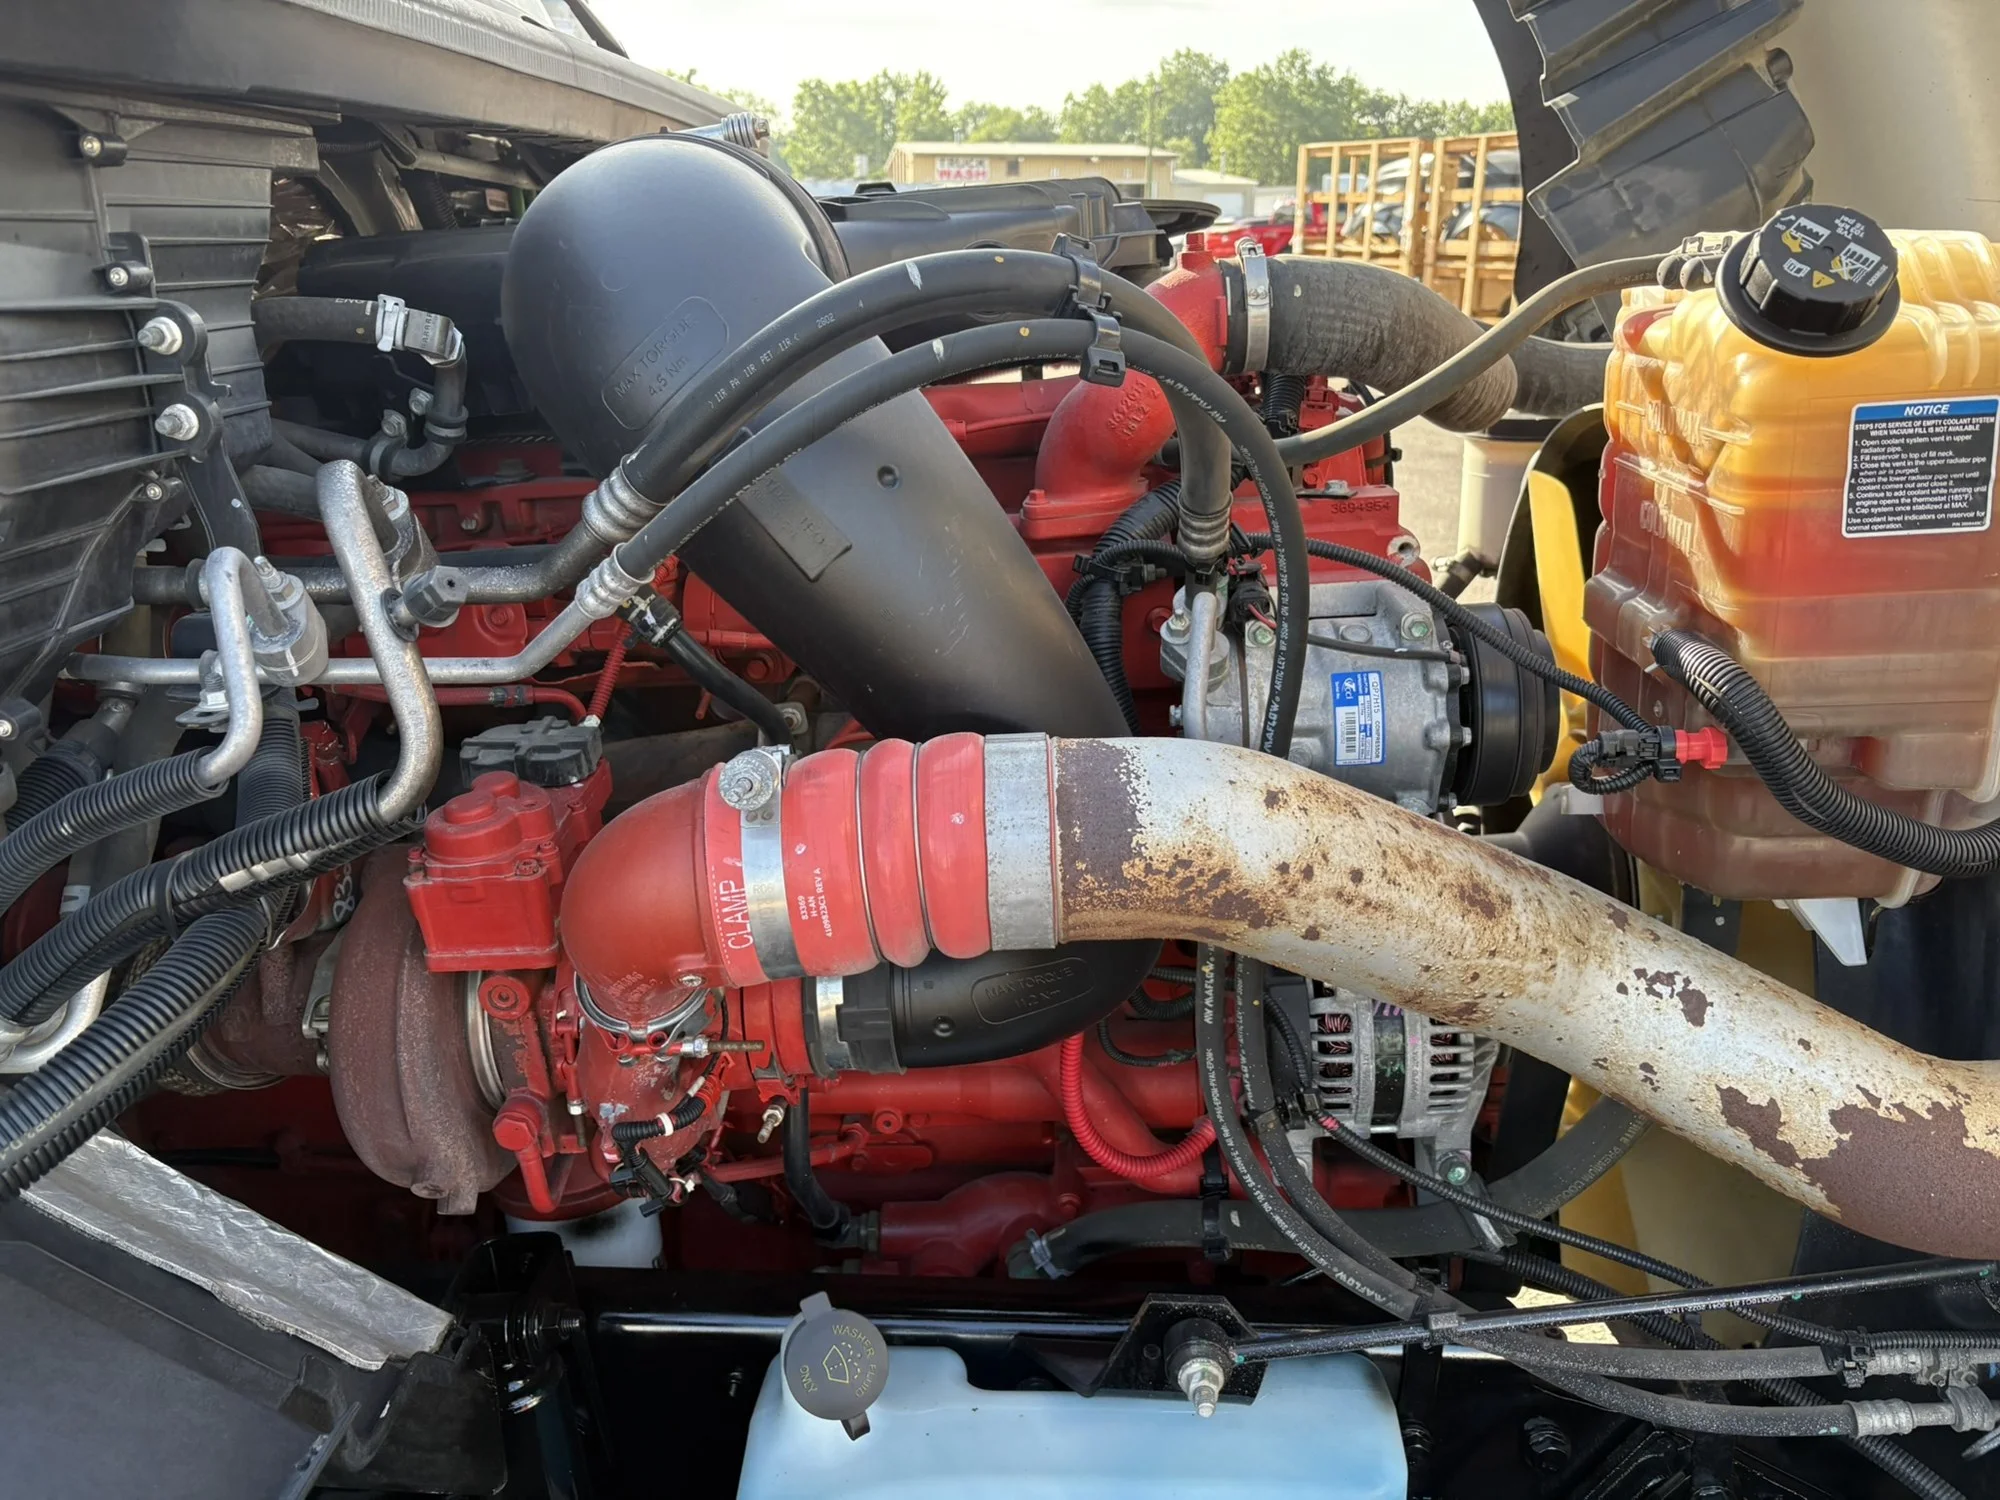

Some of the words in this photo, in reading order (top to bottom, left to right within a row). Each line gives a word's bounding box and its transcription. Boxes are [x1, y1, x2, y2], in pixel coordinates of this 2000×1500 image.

[939, 169, 987, 180] WASH
[615, 367, 641, 398] MAX
[640, 314, 696, 368] TORQUE
[1904, 404, 1950, 416] NOTICE
[1861, 439, 1880, 447] Open
[1881, 437, 1905, 445] coolant
[1906, 436, 1930, 445] system
[1953, 434, 1972, 442] upper
[1860, 446, 1886, 454] radiator
[1909, 452, 1920, 460] top
[1858, 477, 1876, 485] Open
[1912, 495, 1946, 504] thermostat
[1855, 506, 1870, 514] Cap
[1870, 506, 1894, 514] system
[1872, 523, 1903, 531] operation.
[815, 877, 824, 894] REV
[719, 880, 754, 950] CLAMP
[798, 896, 808, 920] 83369
[808, 896, 818, 917] H-AN
[984, 982, 1016, 1000] MAX
[1018, 966, 1075, 989] TORQUE
[1584, 1146, 1622, 1182] PREMIUM
[1335, 1272, 1386, 1302] MAFLOW
[832, 1324, 875, 1358] WASHER
[856, 1364, 876, 1398] FLUID
[800, 1365, 818, 1392] ONLY
